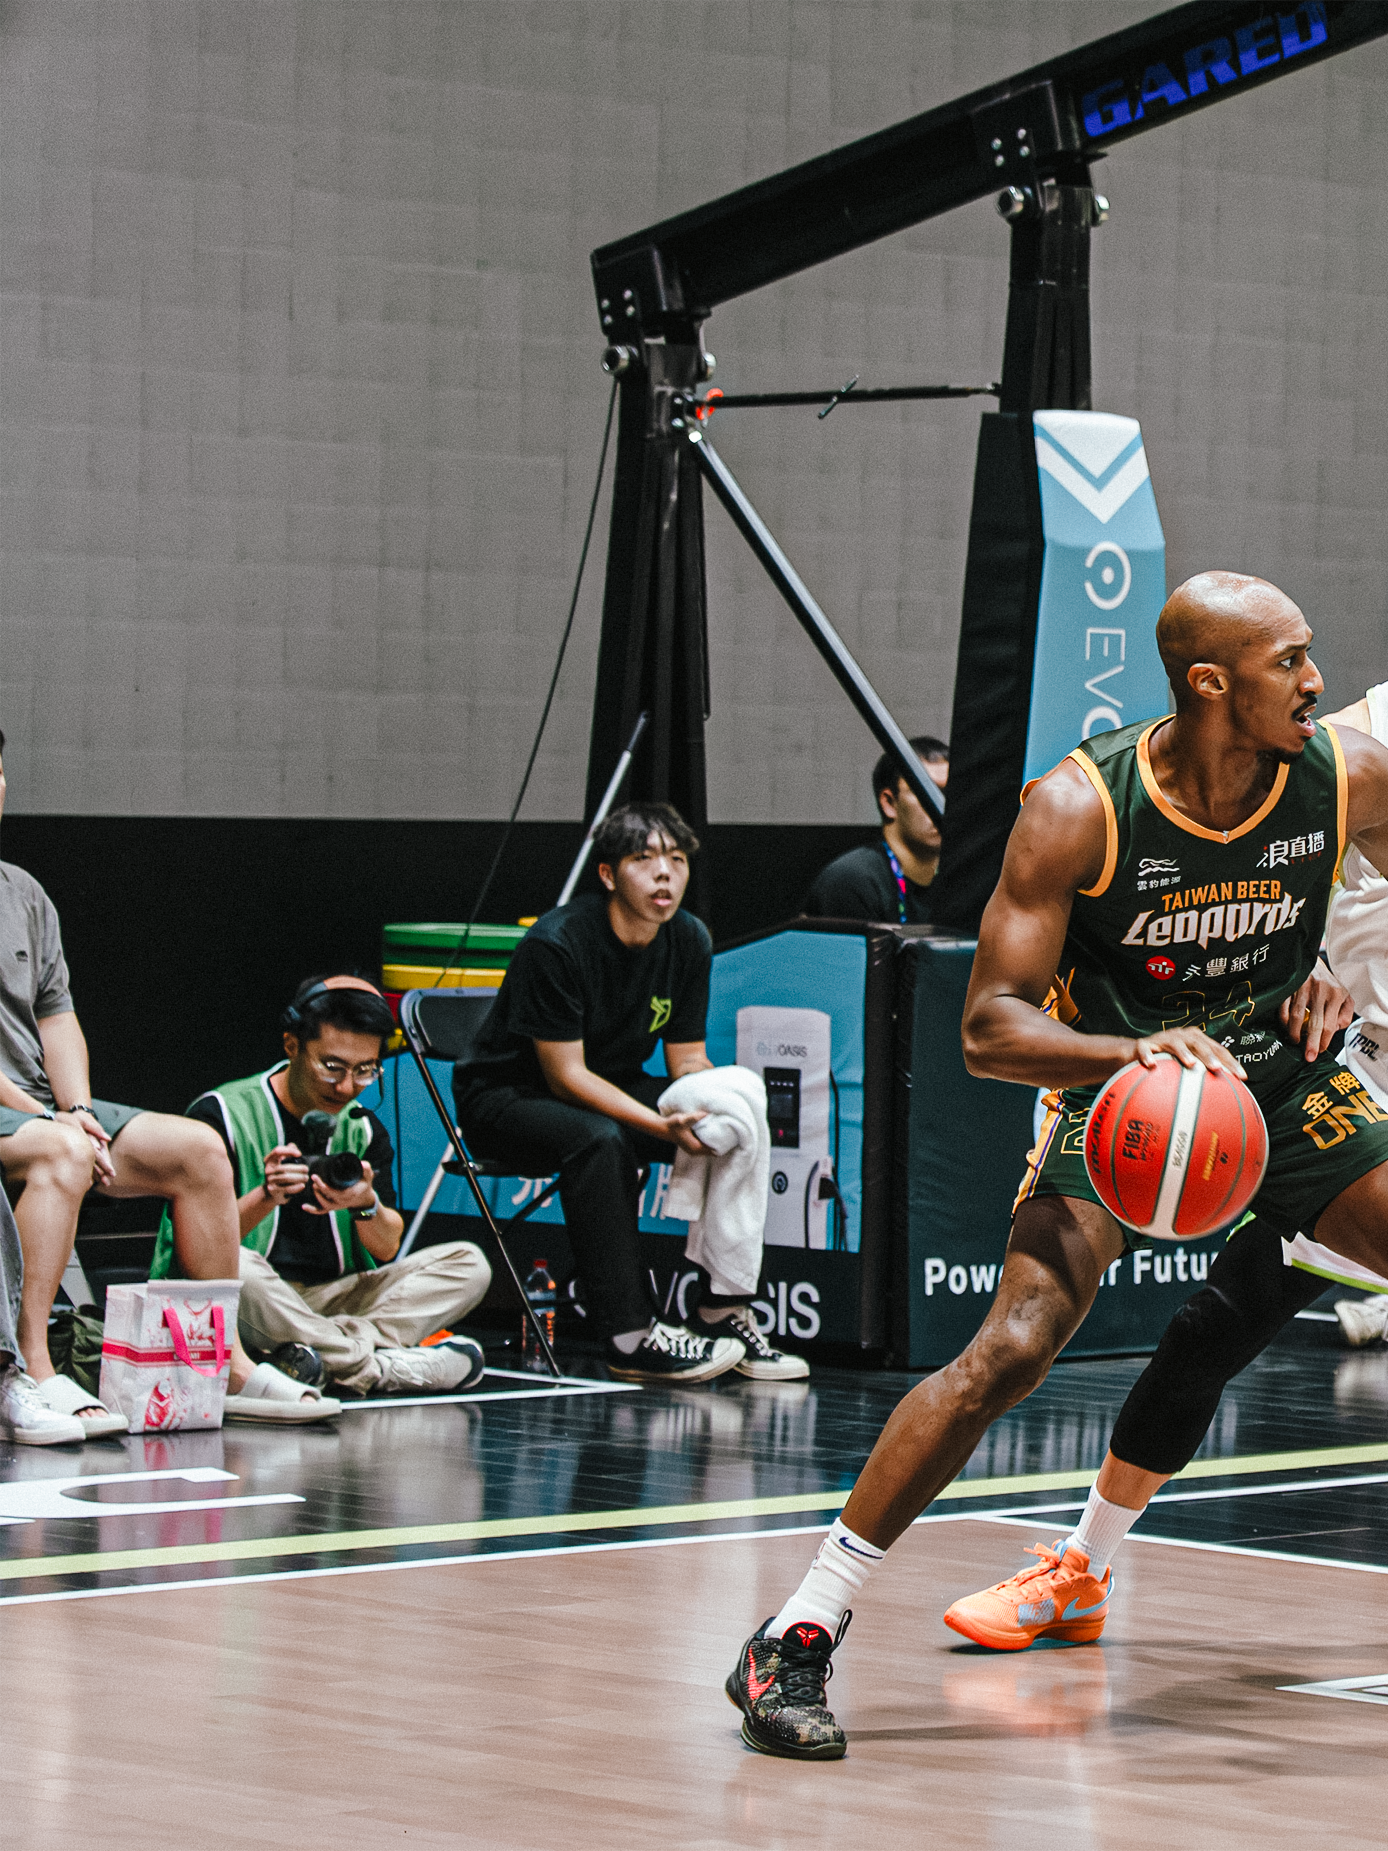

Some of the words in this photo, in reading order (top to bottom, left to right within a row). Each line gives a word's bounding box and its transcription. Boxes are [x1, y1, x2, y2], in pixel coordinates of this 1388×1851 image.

[1082, 0, 1328, 137] GARED
[1256, 831, 1325, 869] 浪直播
[1162, 881, 1233, 913] TAIWAN
[1236, 880, 1282, 900] BEER
[1120, 891, 1307, 951] Leopards
[1302, 1071, 1361, 1120] 金牌
[1122, 1119, 1144, 1161] FIBA
[924, 1257, 1003, 1297] Pow
